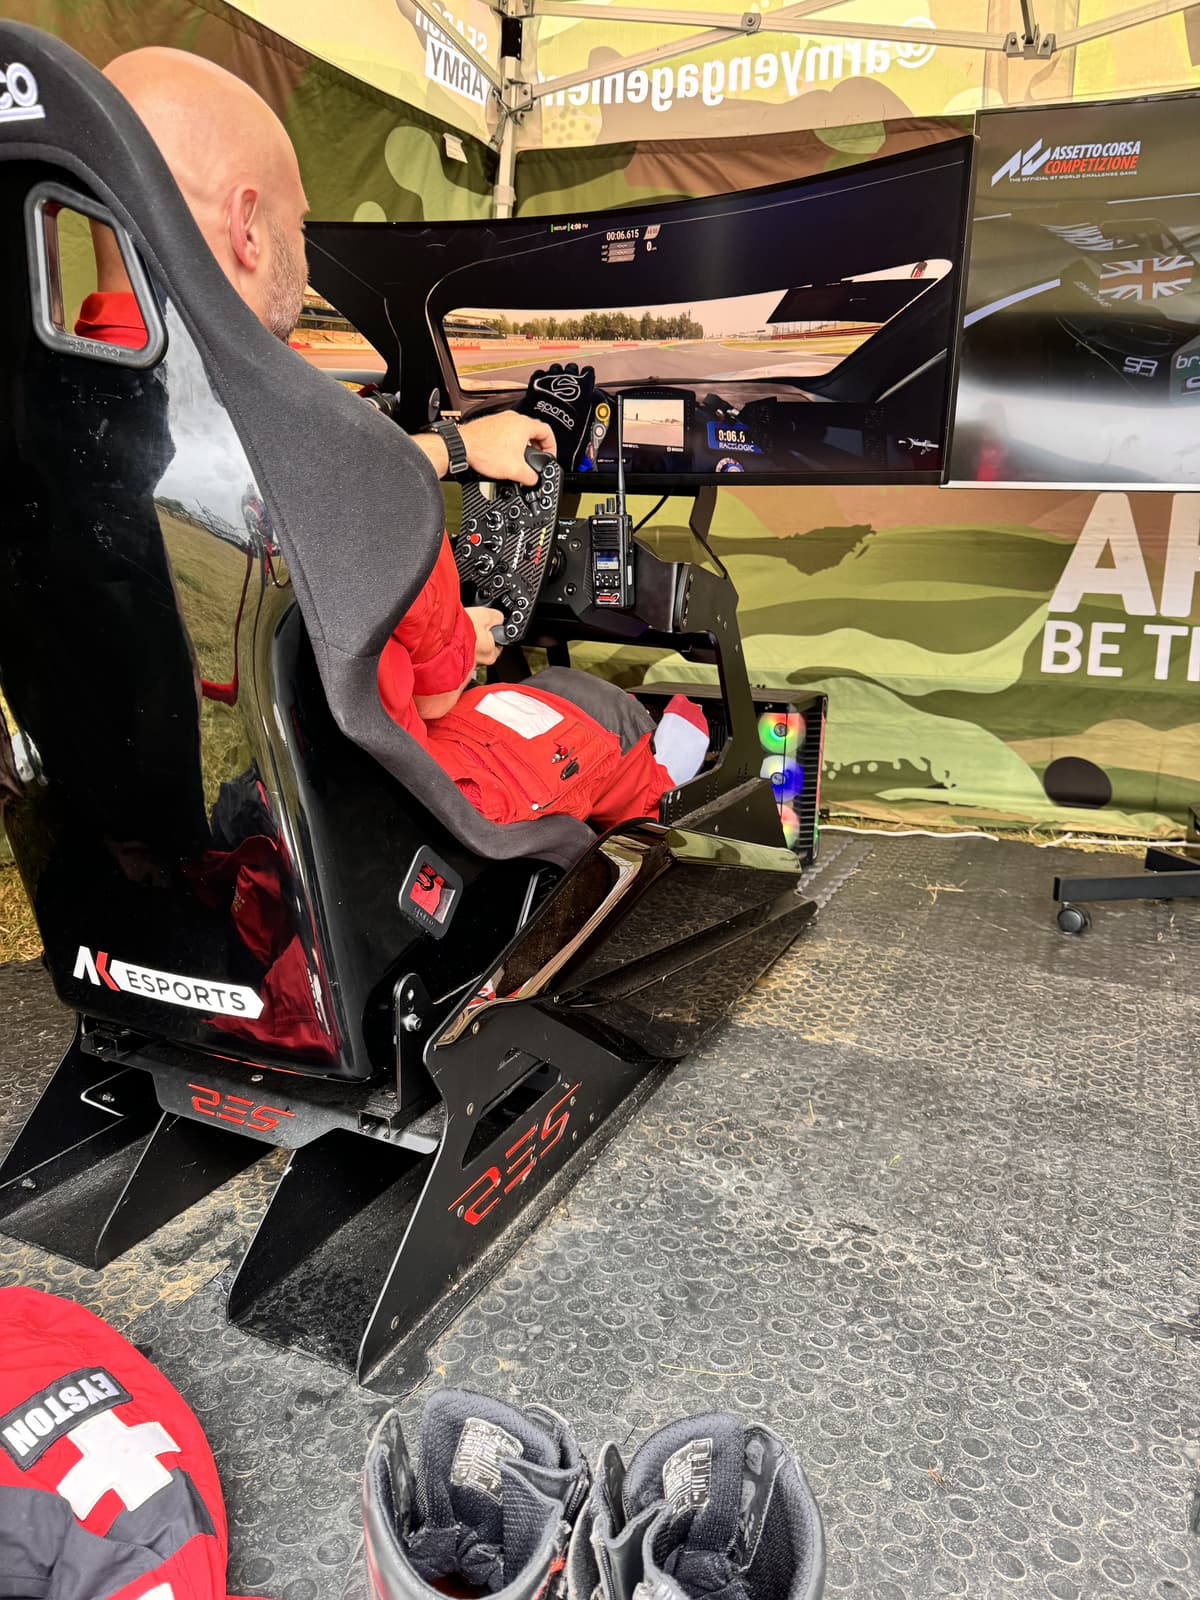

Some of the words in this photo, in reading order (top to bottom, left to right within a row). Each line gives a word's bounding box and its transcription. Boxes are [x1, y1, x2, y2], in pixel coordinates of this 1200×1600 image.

[1050, 143, 1102, 160] ASSETTO
[1102, 140, 1141, 157] CORSA
[1044, 155, 1139, 174] COMPETIZIONE
[606, 229, 640, 241] 00:06.615
[534, 400, 575, 428] sparco
[1040, 620, 1126, 677] BE
[1143, 624, 1200, 682] T
[126, 969, 246, 1011] ESPORTS
[1, 1372, 120, 1457] EYSTON
